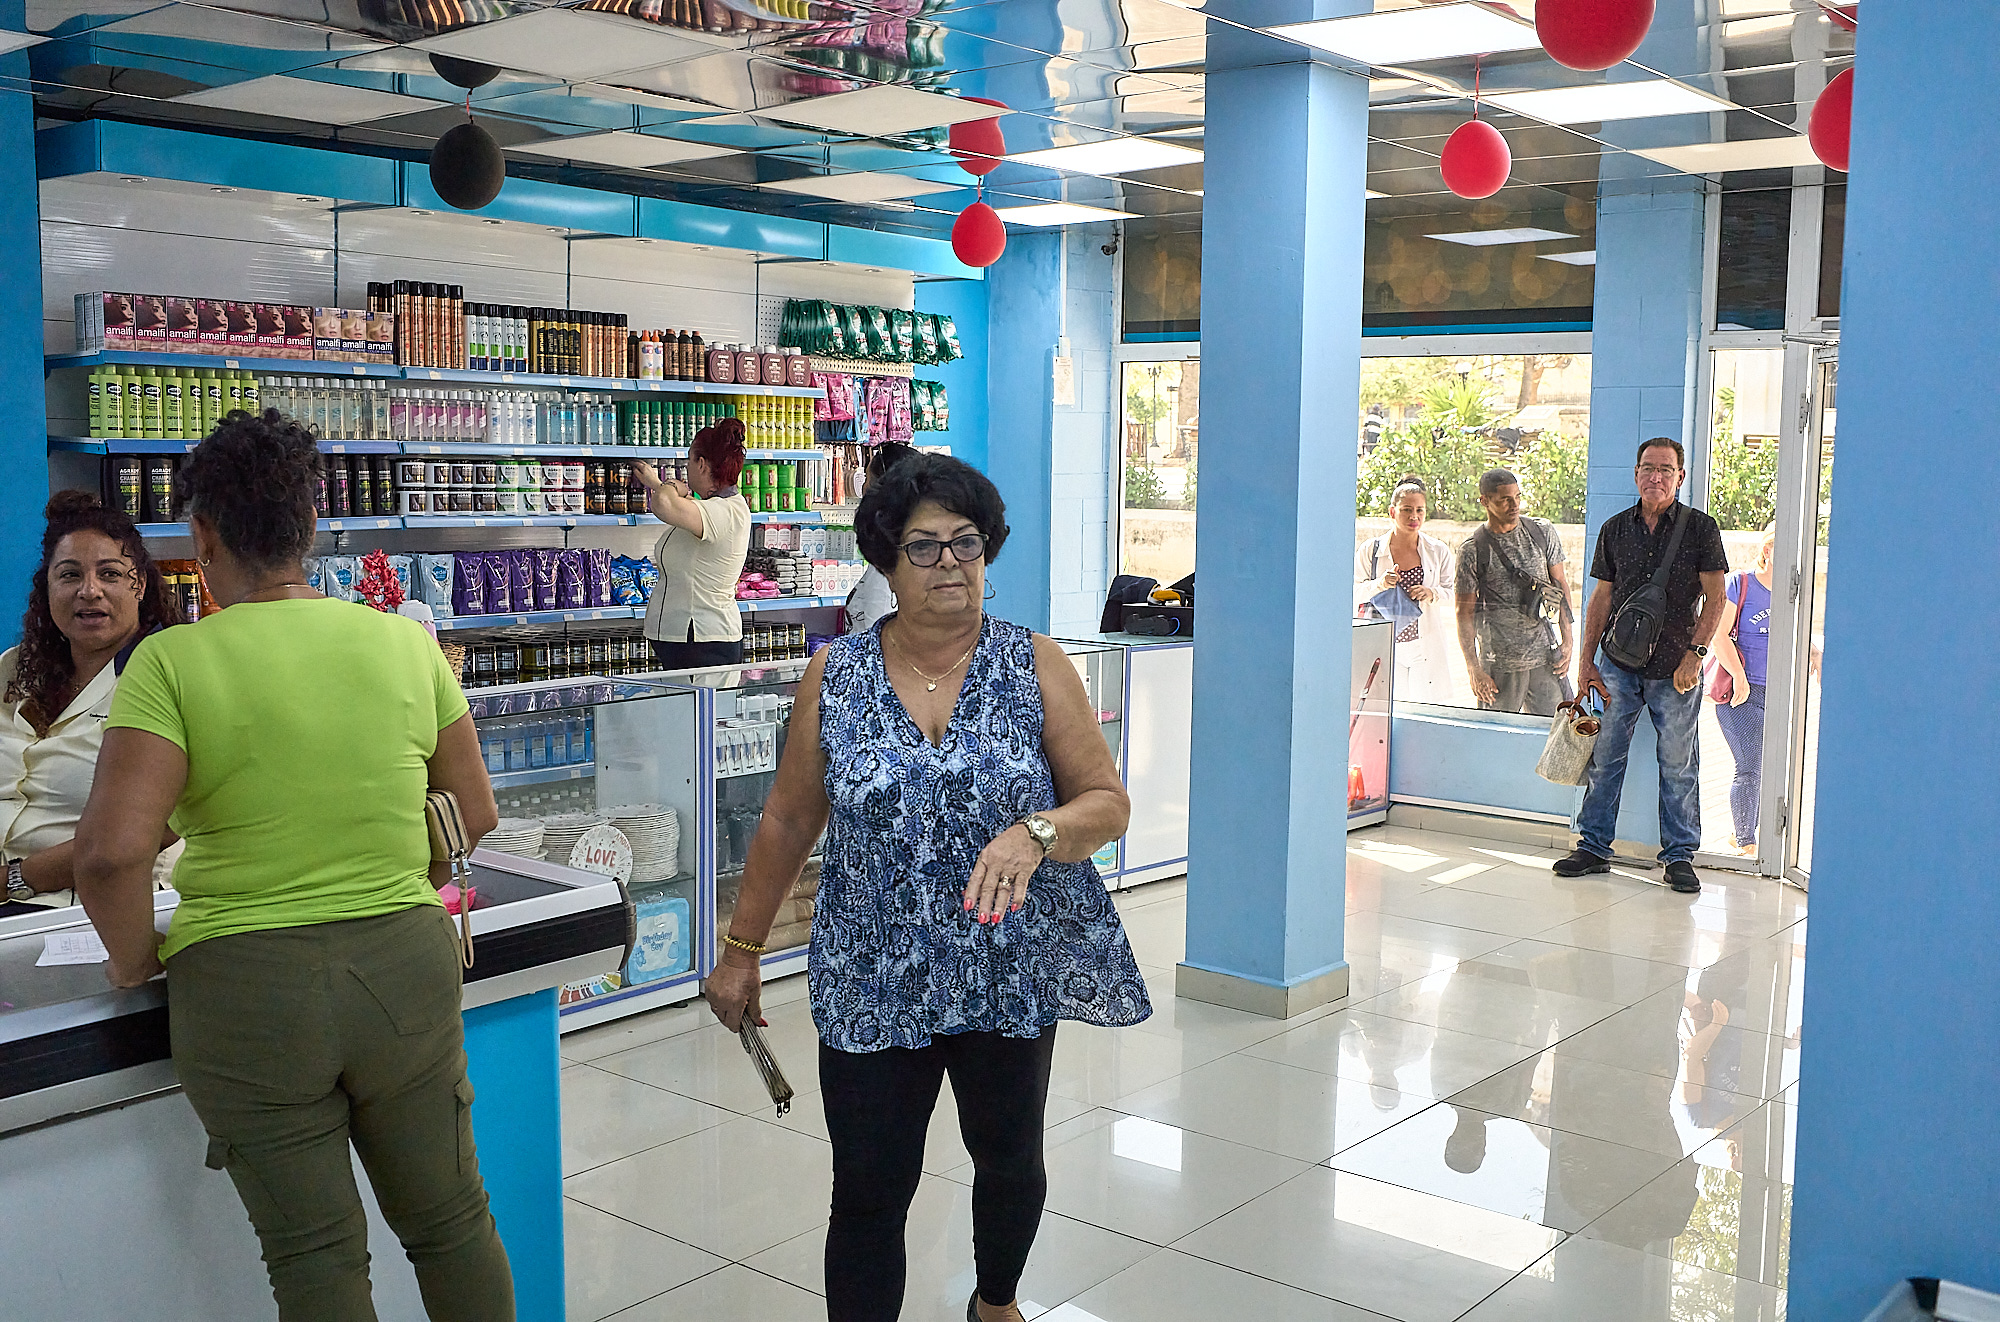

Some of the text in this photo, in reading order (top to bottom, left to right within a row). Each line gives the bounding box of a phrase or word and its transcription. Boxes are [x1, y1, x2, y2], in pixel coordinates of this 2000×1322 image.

[106, 326, 134, 336] amalfi
[138, 328, 166, 338] amalfi
[169, 330, 196, 339] amalfi
[200, 332, 227, 341] amalfi
[230, 334, 256, 342] amalfi
[258, 335, 284, 344] amalfi
[286, 336, 312, 346] amalfi
[316, 338, 340, 348] amalfi
[342, 340, 366, 350] amalfi
[368, 342, 392, 351] amalfi
[586, 846, 616, 868] LOVE
[642, 932, 672, 945] Birthday
[650, 942, 664, 952] Boy
